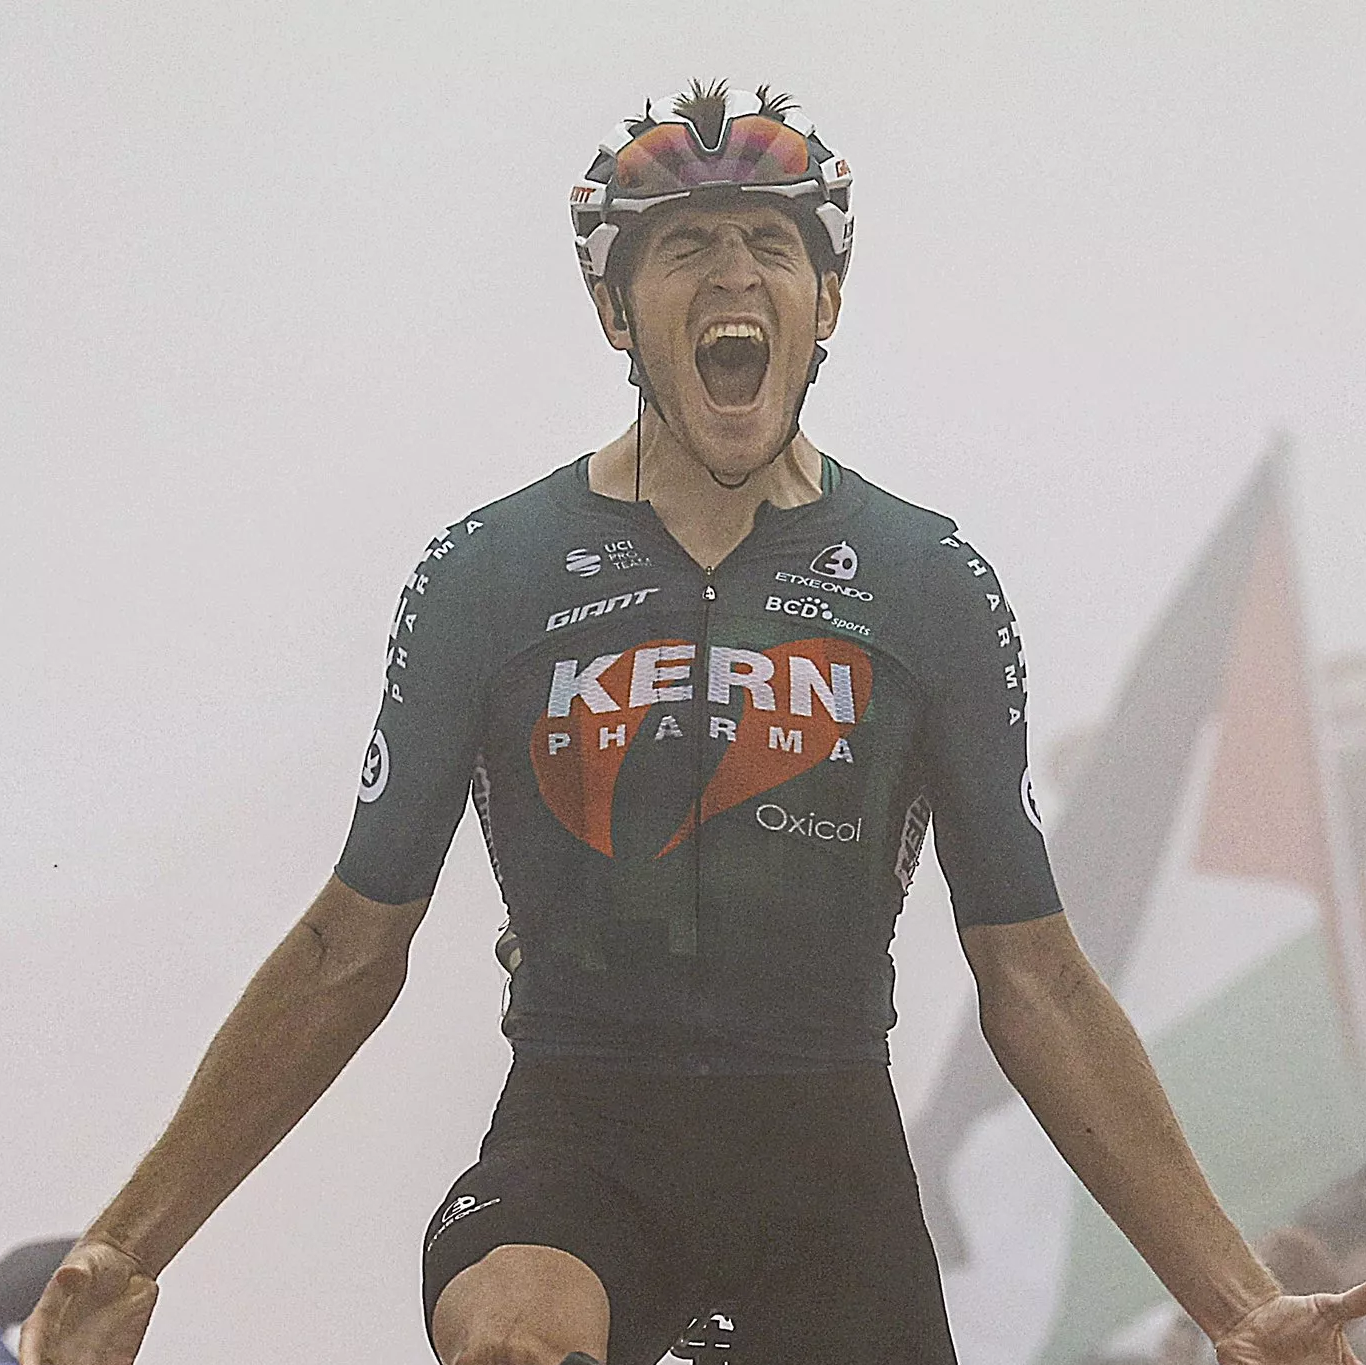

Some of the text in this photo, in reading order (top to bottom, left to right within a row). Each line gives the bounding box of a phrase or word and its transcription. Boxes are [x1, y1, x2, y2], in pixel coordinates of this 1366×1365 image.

[604, 540, 634, 553] UCI
[775, 571, 874, 602] ETXEONDO
[392, 519, 483, 703] PHARMA
[545, 587, 661, 632] GIANT
[831, 617, 872, 636] sports
[940, 536, 1022, 726] PHARMA
[547, 644, 856, 724] KERN
[548, 715, 854, 764] PHARMA
[755, 803, 863, 842] Oxicol
